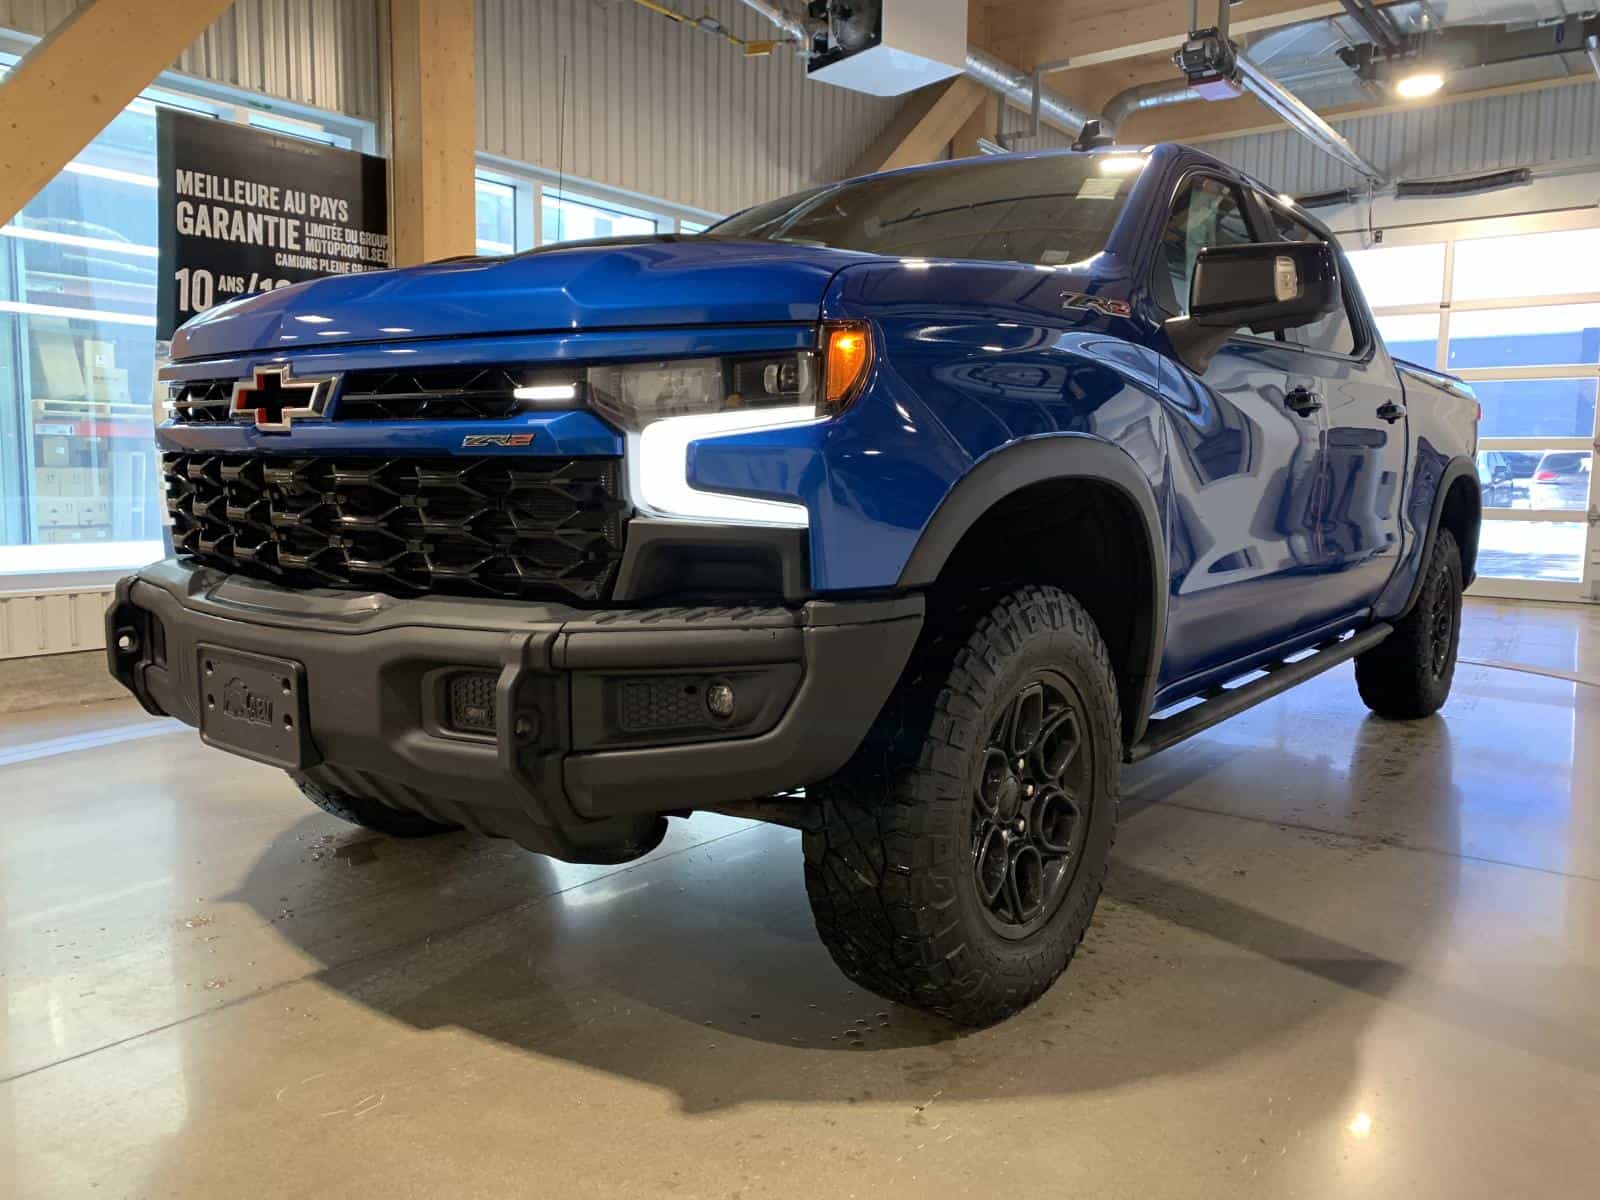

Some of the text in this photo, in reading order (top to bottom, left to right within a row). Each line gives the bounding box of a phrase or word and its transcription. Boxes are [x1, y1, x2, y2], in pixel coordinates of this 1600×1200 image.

[176, 169, 349, 222] MEILLEURE AU PAYS
[176, 201, 301, 250] GARANTIE
[305, 221, 343, 241] LIMITÉE
[344, 228, 358, 244] DU
[275, 252, 318, 270] CAMIONS
[319, 258, 351, 273] PLEINE
[175, 268, 214, 312] 10
[218, 274, 245, 293] ANS
[461, 433, 534, 447] ZR2
